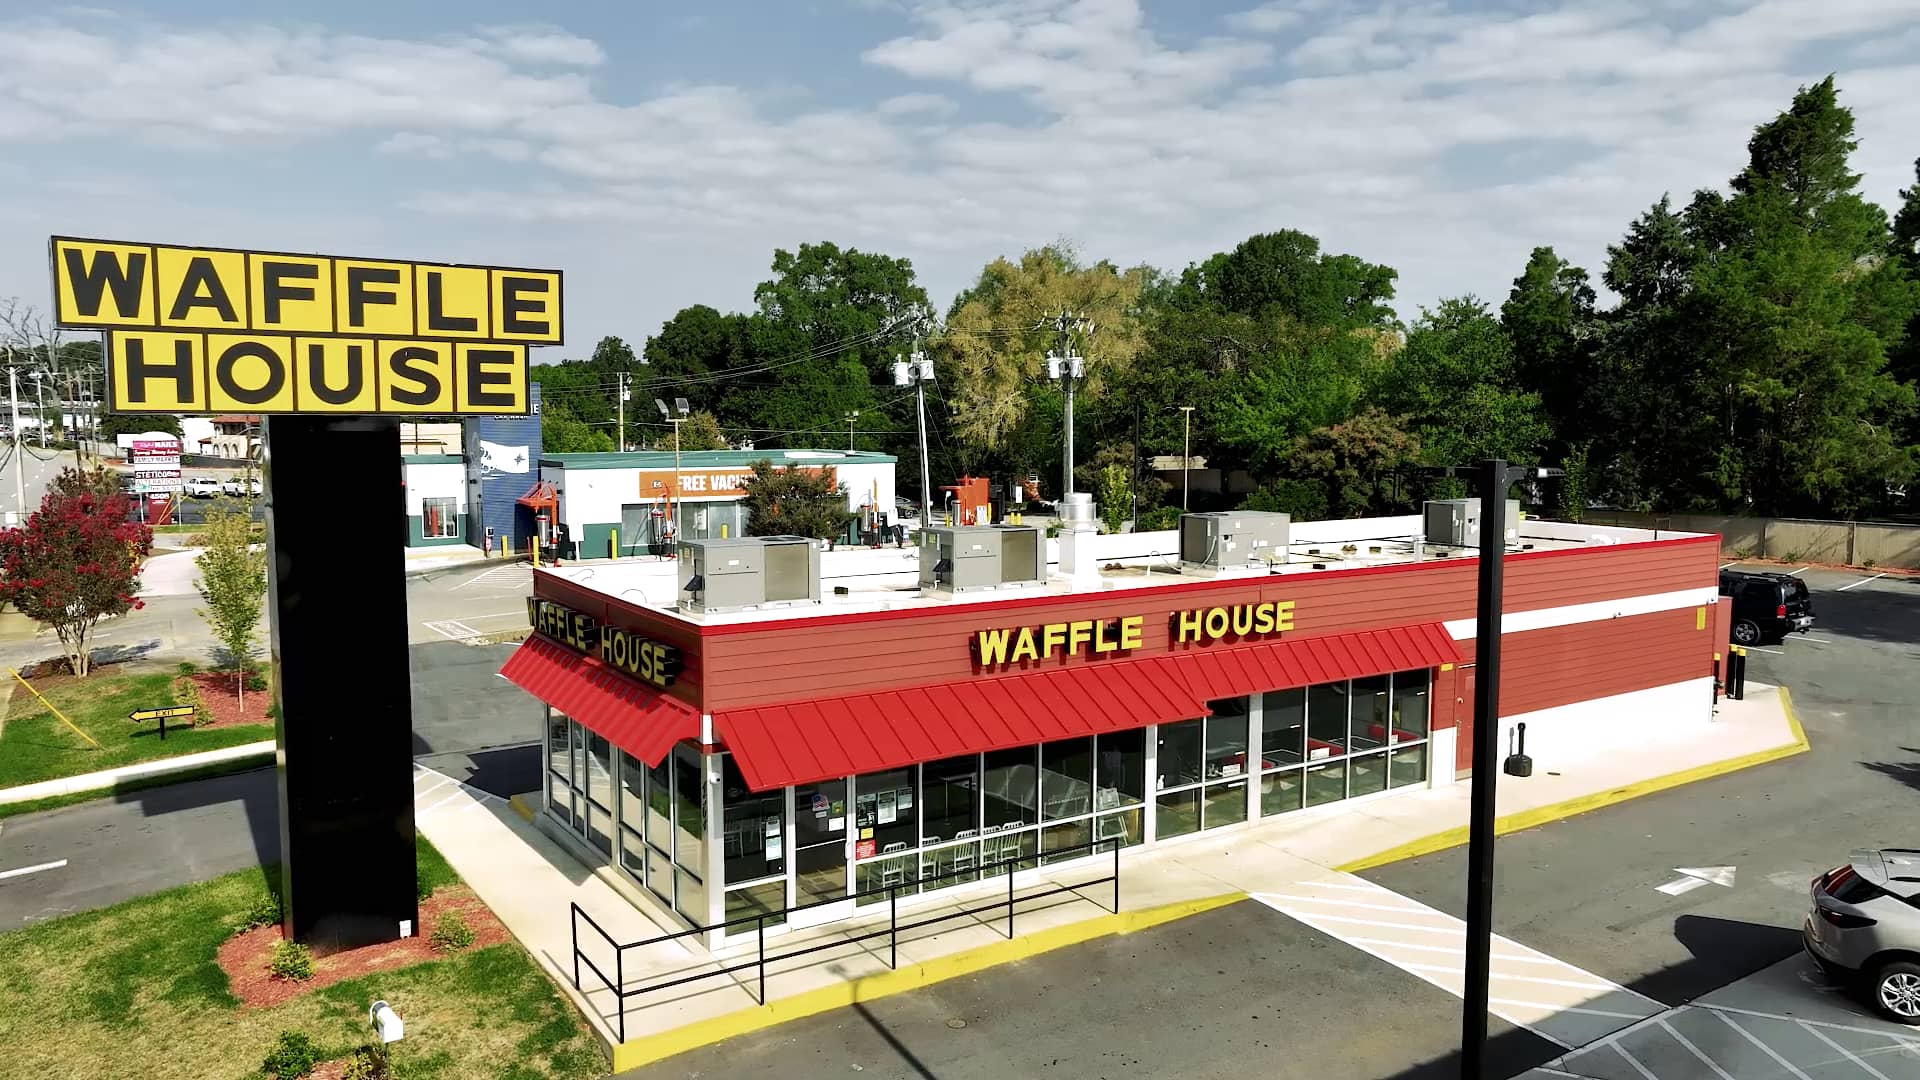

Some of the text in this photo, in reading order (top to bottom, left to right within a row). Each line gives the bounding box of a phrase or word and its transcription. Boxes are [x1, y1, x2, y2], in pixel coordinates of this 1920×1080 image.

[63, 248, 549, 335] WAFFLE
[125, 338, 516, 407] HOUSE
[527, 597, 666, 687] WAFFLE HOUSE
[979, 600, 1296, 666] WAFFLE HOUSE
